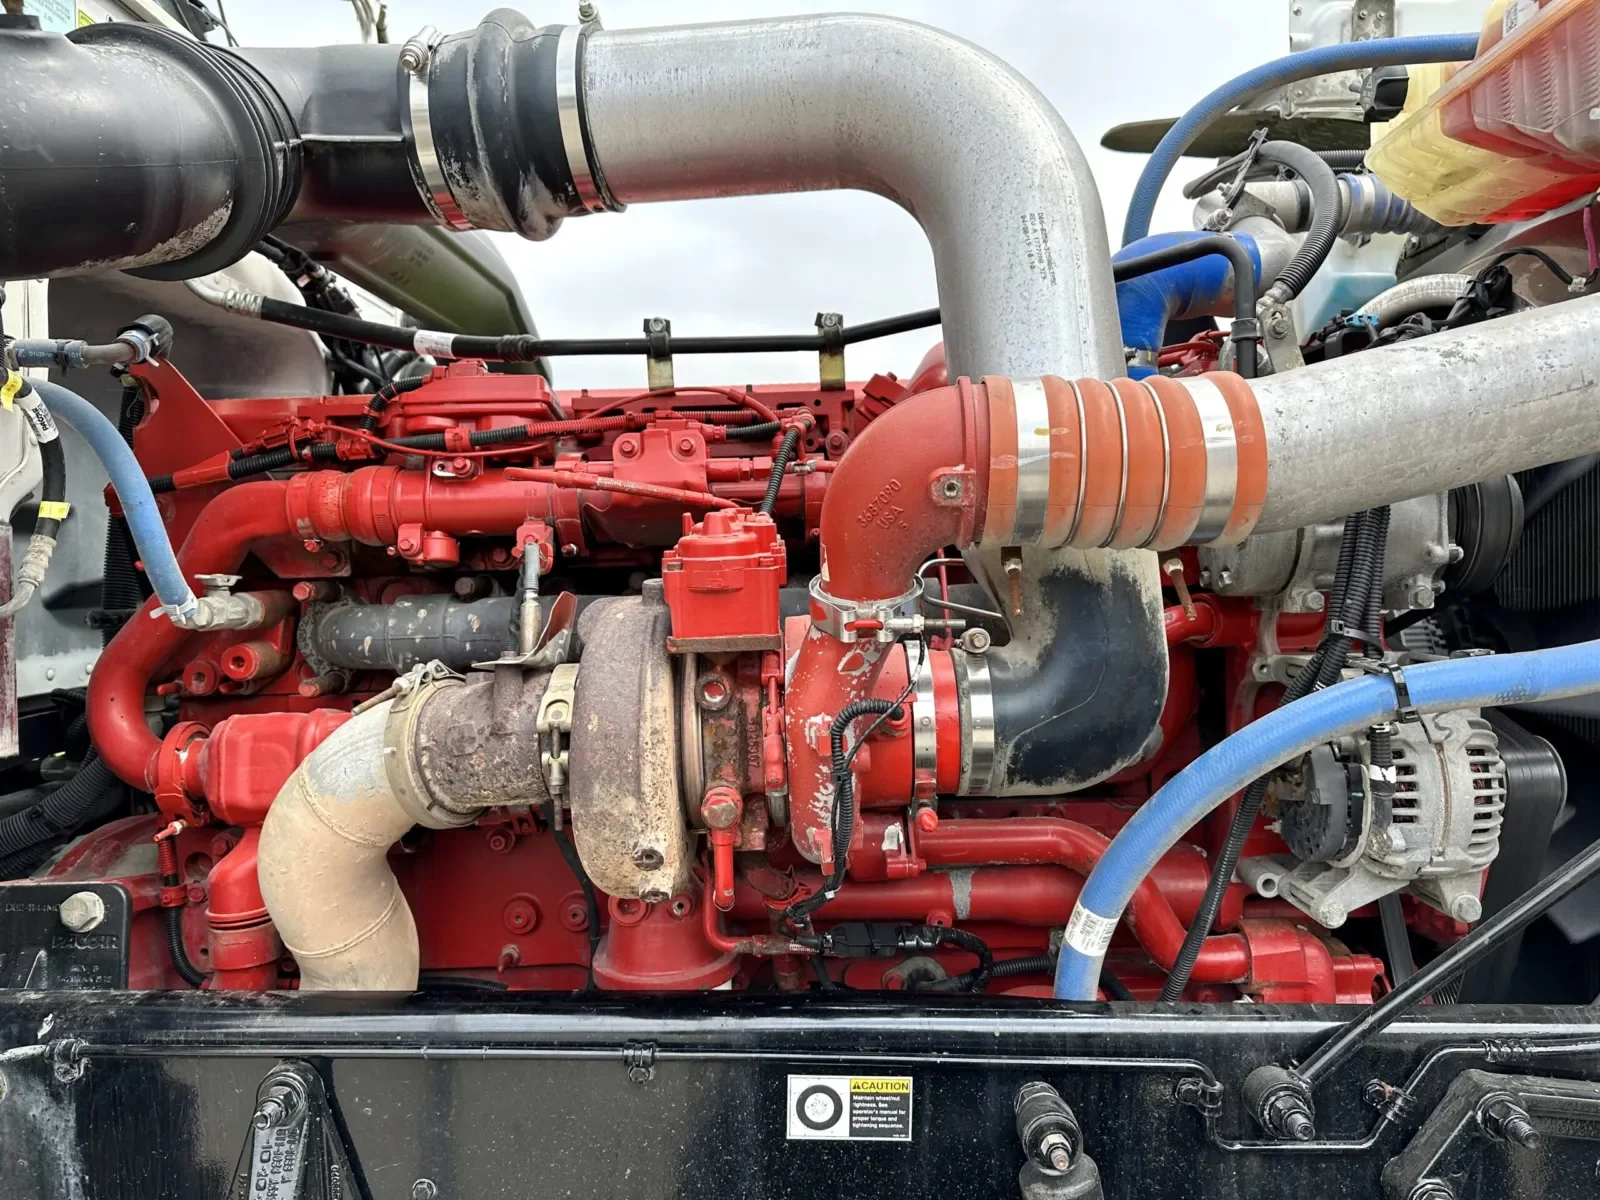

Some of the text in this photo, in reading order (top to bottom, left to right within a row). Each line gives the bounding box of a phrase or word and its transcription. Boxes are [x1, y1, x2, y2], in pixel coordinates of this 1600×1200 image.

[856, 478, 902, 528] 3687090
[876, 504, 904, 530] USA
[51, 934, 119, 949] PACCAR
[861, 1081, 909, 1090] CAUTION
